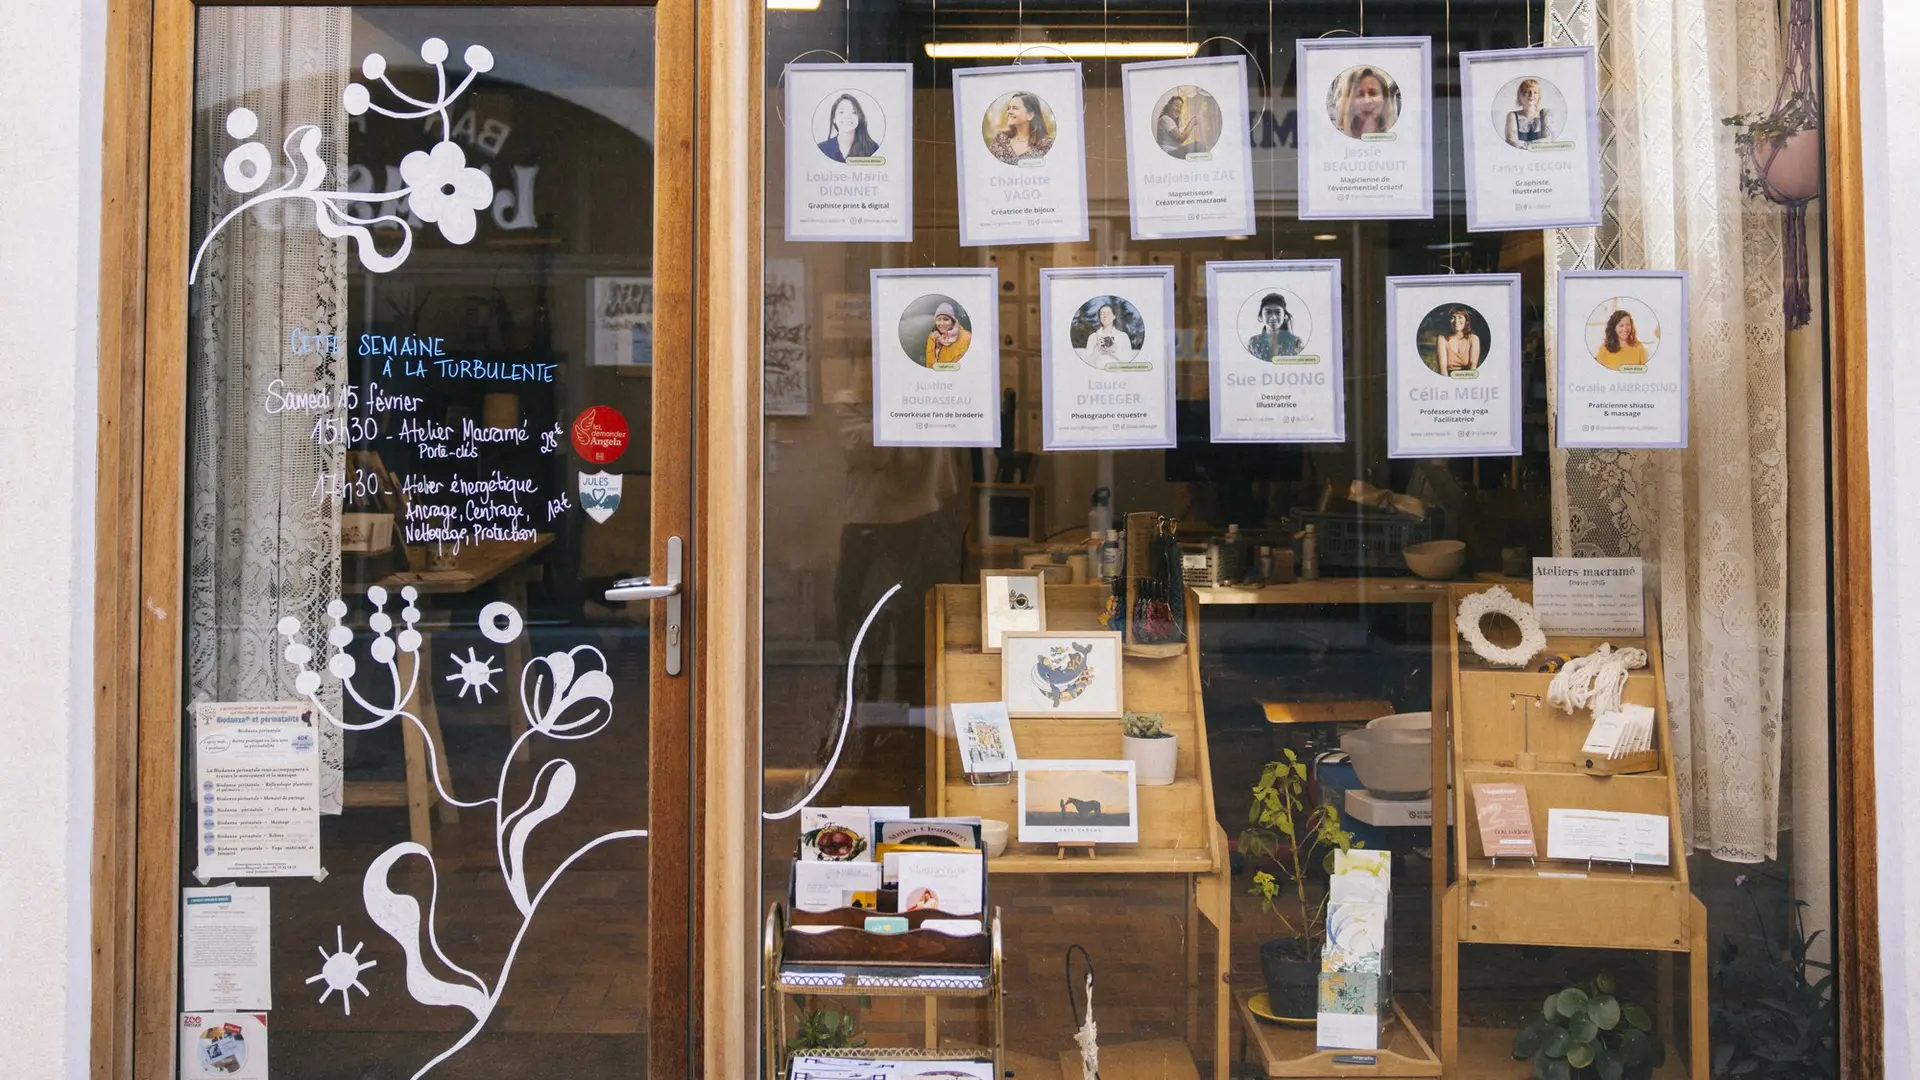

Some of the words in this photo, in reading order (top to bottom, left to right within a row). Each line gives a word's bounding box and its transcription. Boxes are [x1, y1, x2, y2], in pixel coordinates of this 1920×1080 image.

[1344, 145, 1382, 160] Jessie
[1323, 160, 1408, 172] BEAUDENUIT
[806, 171, 889, 182] Louise-Marie
[990, 175, 1051, 187] Charlotte
[1144, 171, 1210, 187] Marjolaine
[1212, 170, 1237, 181] ZAC
[1340, 176, 1380, 185] Magicienne
[1515, 180, 1549, 188] Graphiste
[819, 185, 879, 197] DIONNET
[1003, 189, 1041, 201] VAGO
[1512, 187, 1554, 195] Illustratrice
[808, 202, 842, 211] Graphiste
[843, 202, 860, 211] print
[868, 202, 890, 211] digital
[1155, 199, 1186, 207] Créatrice
[1196, 197, 1228, 205] macramé
[991, 208, 1023, 216] Créatrice
[1034, 206, 1056, 215] bijoux
[382, 358, 392, 378] À
[405, 360, 428, 378] LA
[434, 359, 559, 383] TURBULENTE
[1088, 379, 1127, 391] Laure
[1226, 373, 1257, 387] Sue
[1262, 372, 1326, 386] DUONG
[916, 381, 953, 392] Justine
[1568, 383, 1607, 393] Coralie
[1608, 383, 1678, 393] AMBROSINO
[265, 379, 331, 415] Samedi
[337, 384, 359, 411] 15
[366, 382, 424, 415] février
[1261, 393, 1292, 402] Designer
[1409, 385, 1449, 402] Célia
[1454, 386, 1501, 404] MEIJE
[1256, 401, 1297, 409] Illustratrice
[954, 411, 984, 419] broderie
[1071, 412, 1116, 420] Photographe
[1116, 411, 1148, 420] équestre
[1420, 408, 1461, 416] Professeure
[1472, 408, 1489, 417] yoga
[1611, 411, 1641, 419] massage
[310, 416, 378, 448] 15h30
[399, 418, 455, 442] Atelier
[462, 418, 530, 449] Macramé
[591, 430, 627, 438] demandez
[590, 437, 622, 448] Angela
[311, 468, 379, 504] 17h30
[402, 475, 444, 499] Atelier
[450, 471, 538, 504] énergétique
[583, 477, 609, 487] JULES
[1535, 566, 1579, 577] Ateliers
[1583, 565, 1636, 577] macramé
